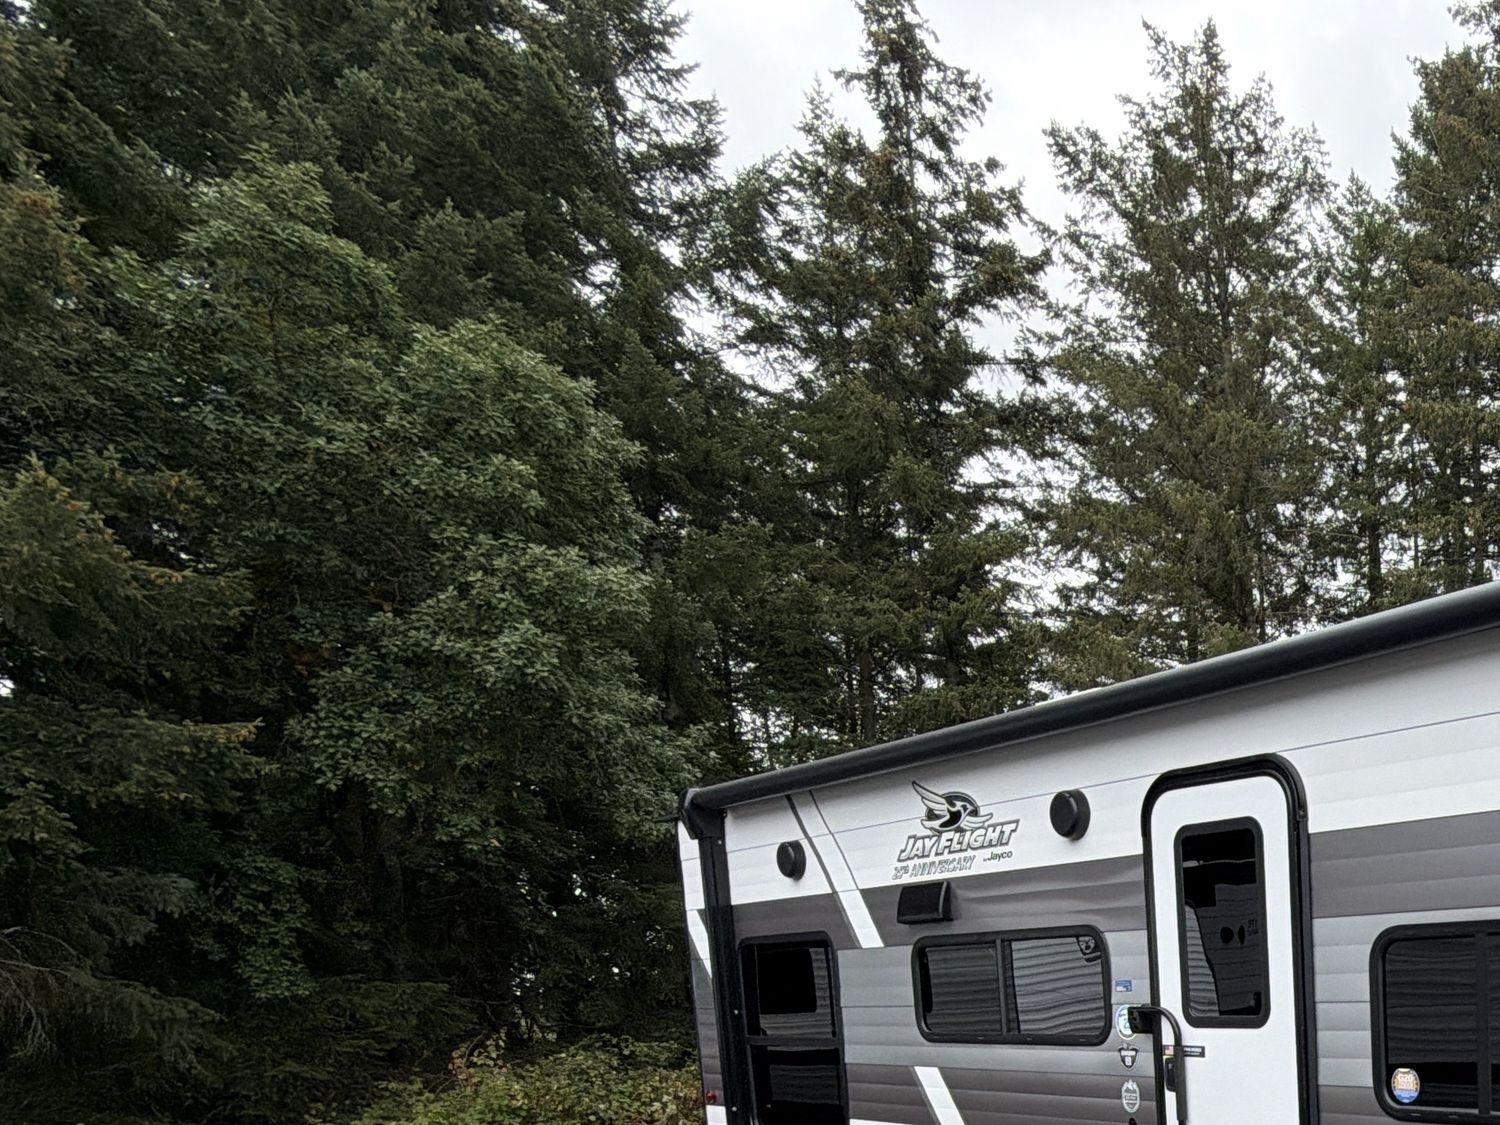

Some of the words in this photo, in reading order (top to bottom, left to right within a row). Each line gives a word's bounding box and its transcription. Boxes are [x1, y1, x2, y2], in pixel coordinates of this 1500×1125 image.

[897, 833, 939, 862] JAY
[936, 820, 1020, 856] FLIGHT
[910, 855, 976, 877] ANNIVERSARY
[987, 850, 1013, 862] Jayco
